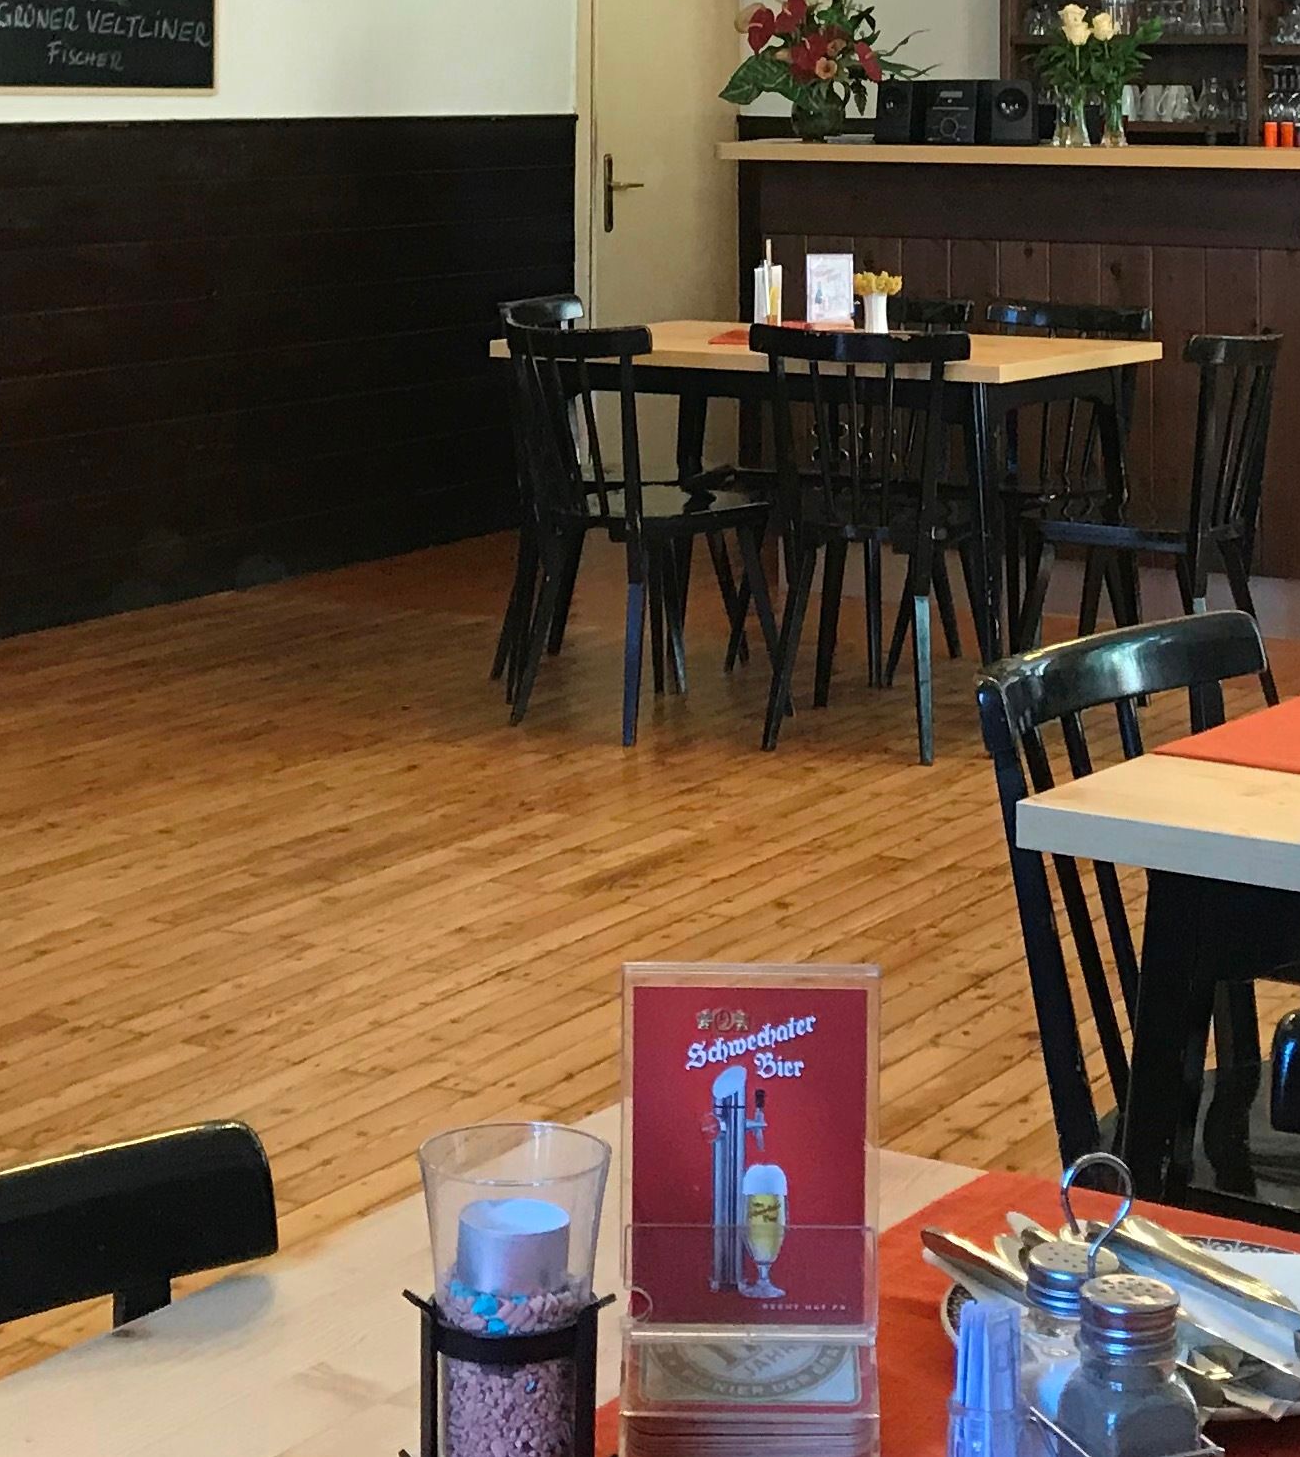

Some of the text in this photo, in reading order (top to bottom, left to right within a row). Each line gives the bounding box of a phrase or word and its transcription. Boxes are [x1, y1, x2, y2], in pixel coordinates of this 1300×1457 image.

[85, 7, 213, 49] VELTLINER
[46, 39, 125, 72] FISCHER
[684, 1012, 818, 1072] Schwechater
[752, 1051, 806, 1080] Bier
